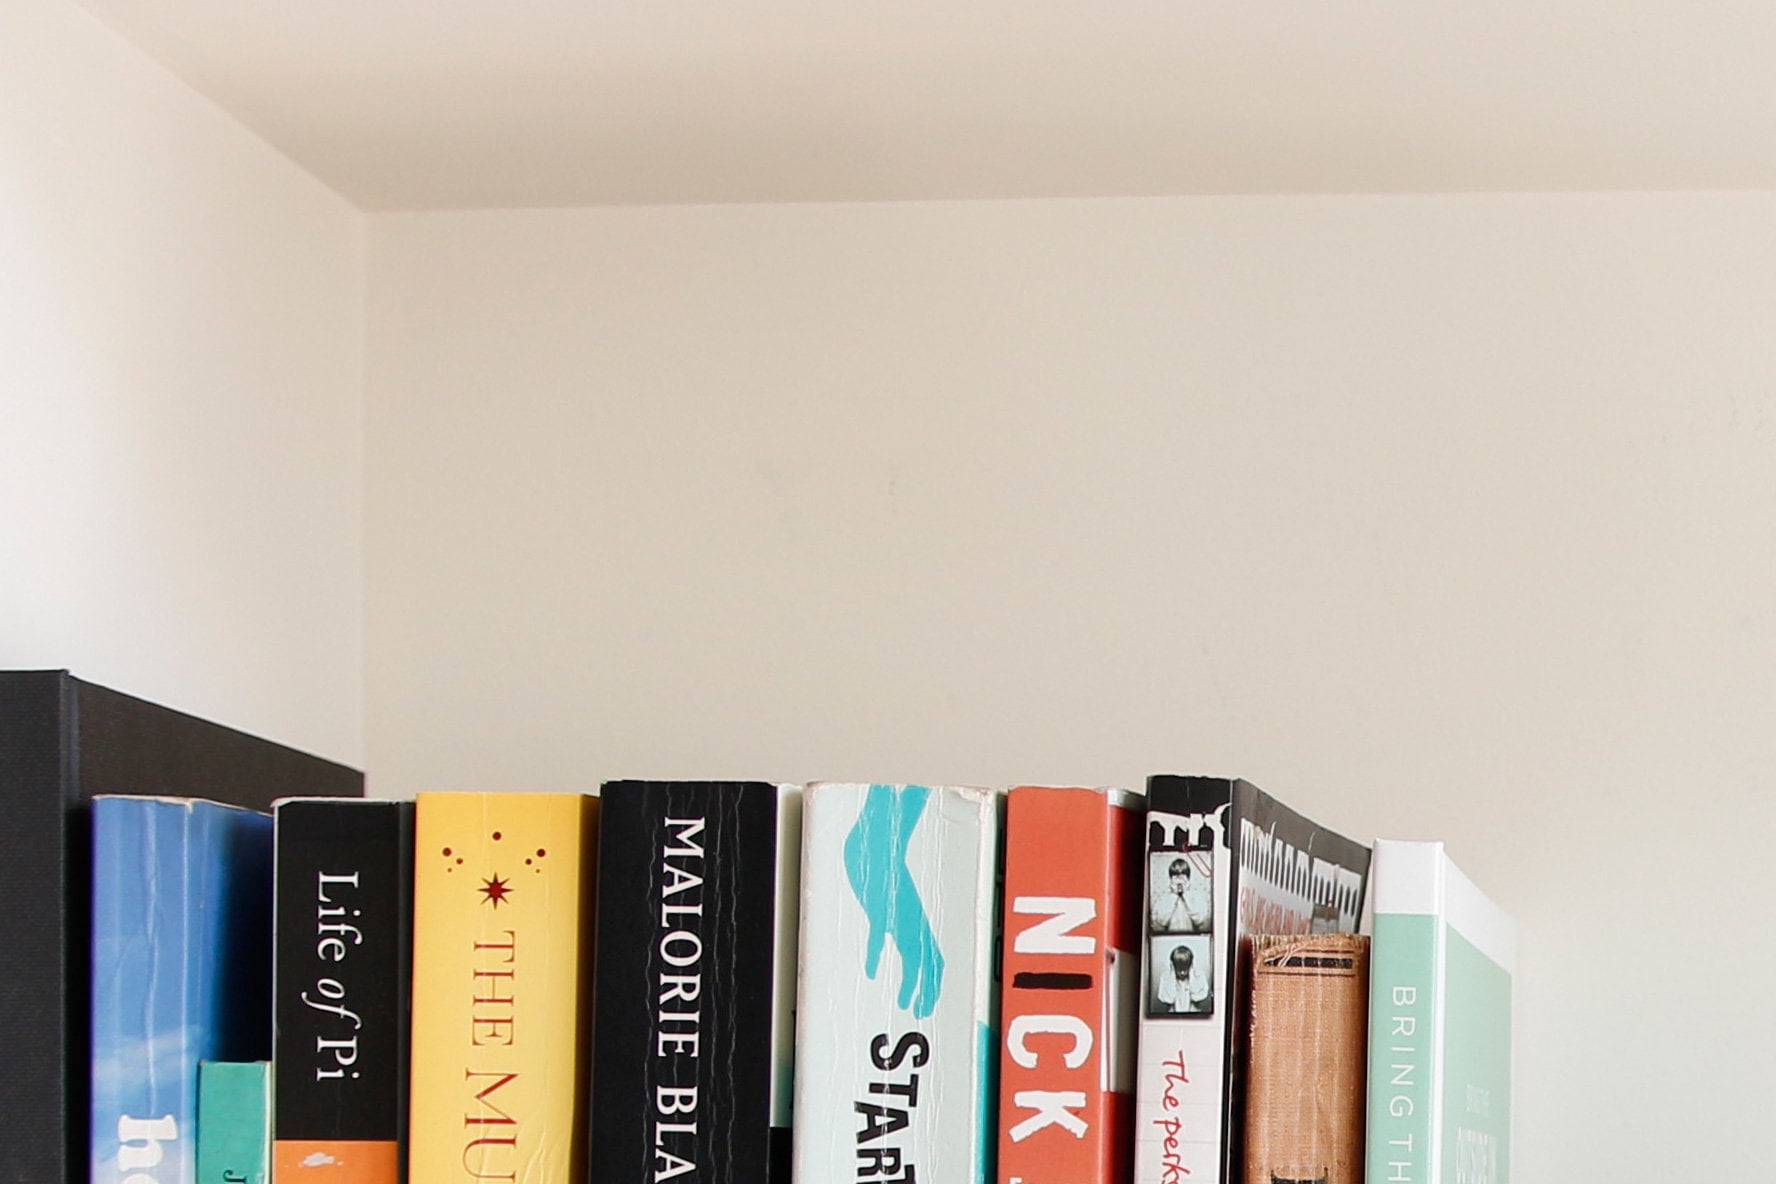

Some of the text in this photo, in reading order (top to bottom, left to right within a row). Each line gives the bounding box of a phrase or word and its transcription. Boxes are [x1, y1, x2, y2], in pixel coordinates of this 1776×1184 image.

[301, 871, 362, 1082] Life of Pi
[471, 930, 516, 1048] THE
[657, 816, 705, 1058] MALORIE
[1007, 896, 1098, 1142] NICK
[1161, 1050, 1190, 1112] The
[1387, 986, 1417, 1119] BRING
